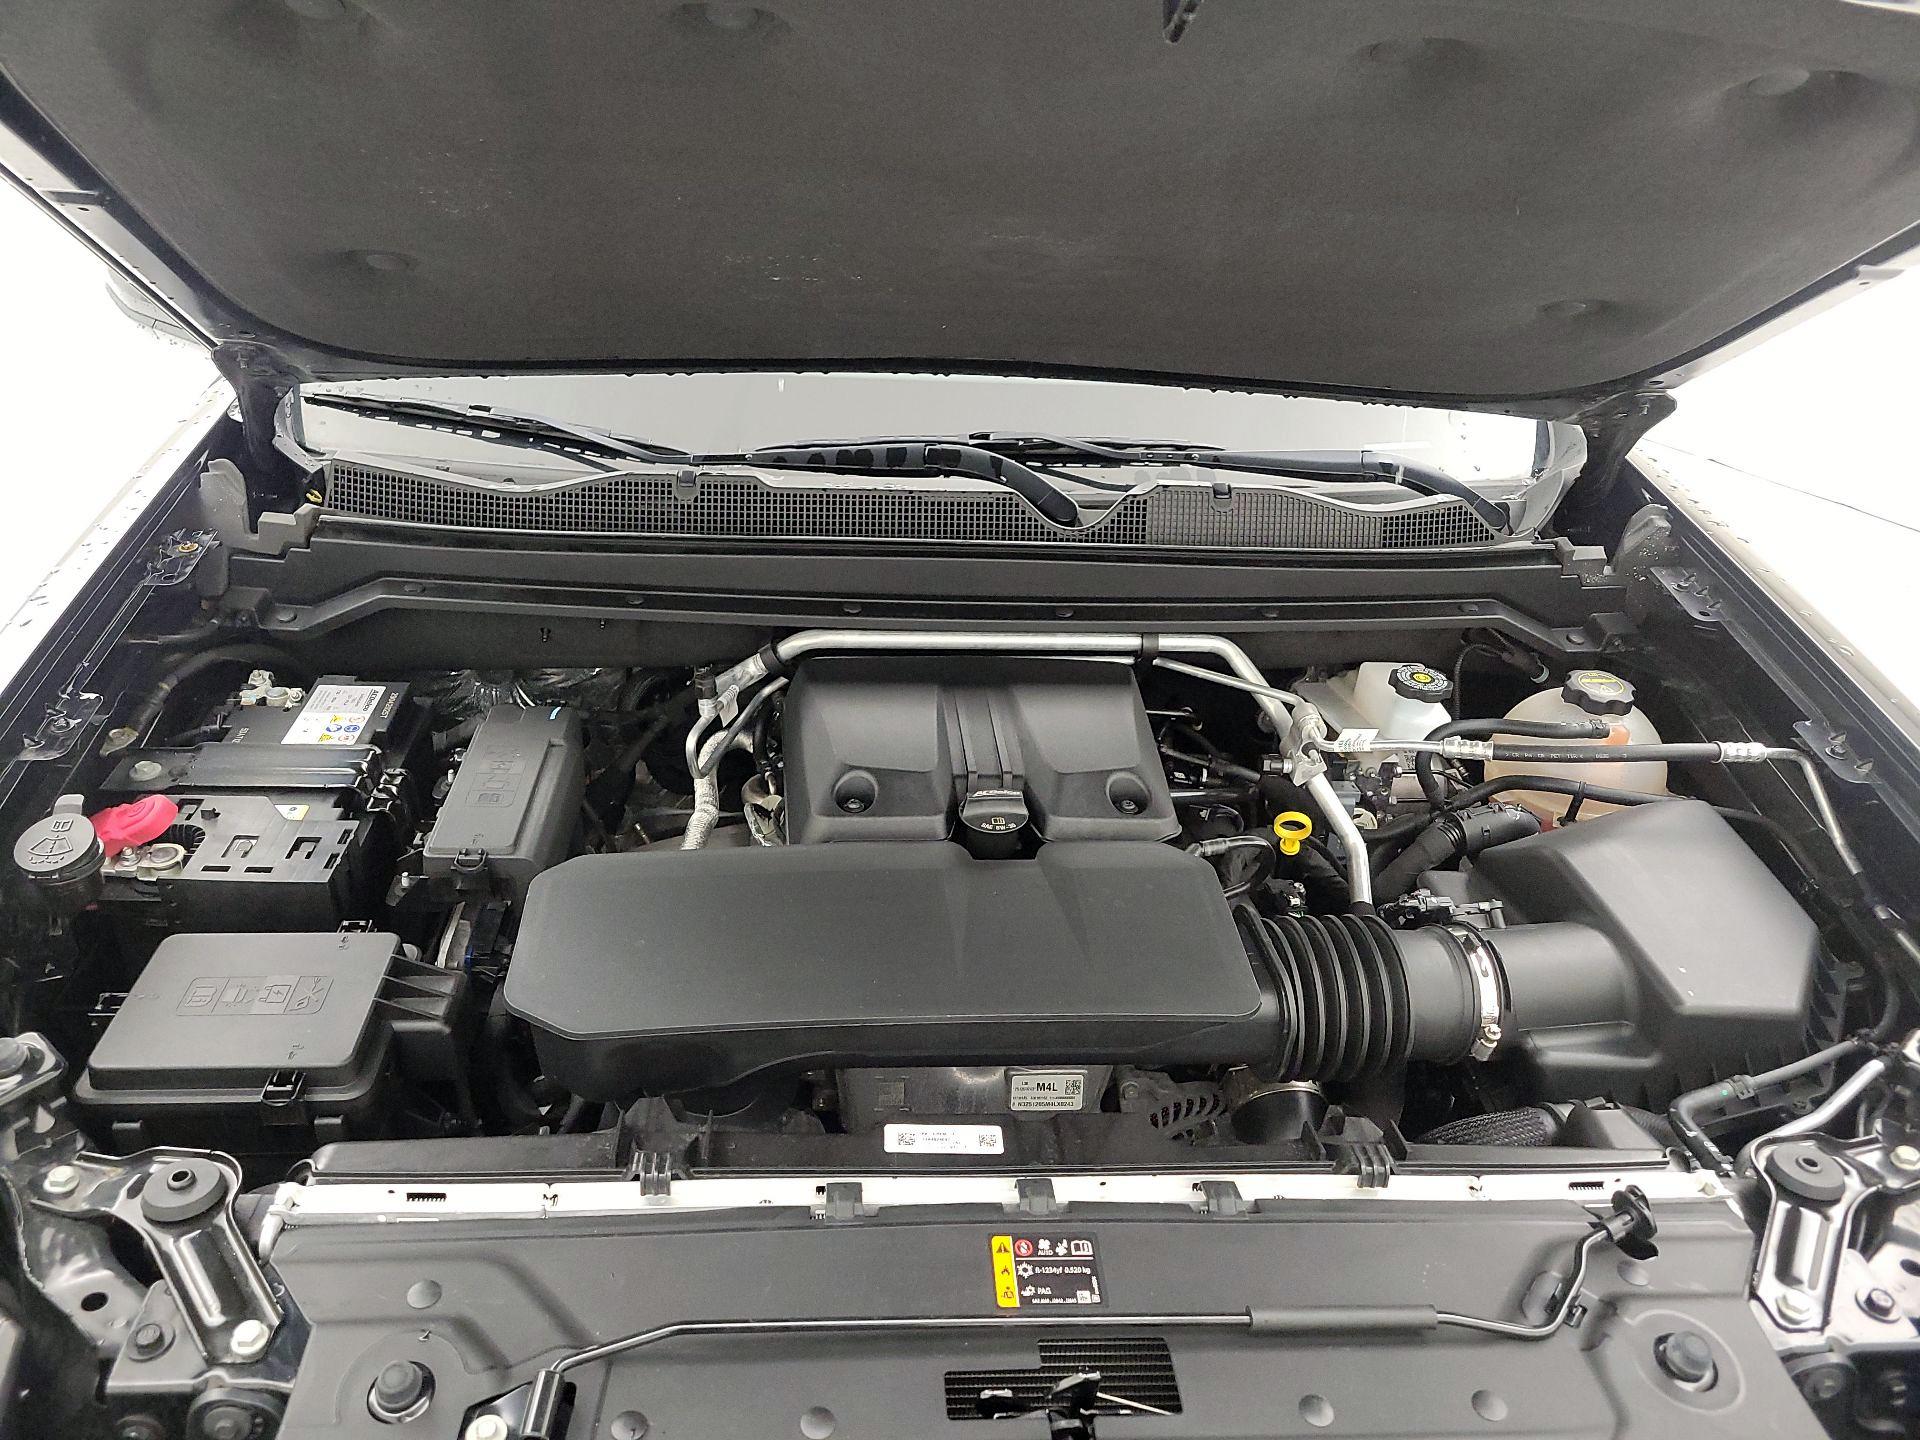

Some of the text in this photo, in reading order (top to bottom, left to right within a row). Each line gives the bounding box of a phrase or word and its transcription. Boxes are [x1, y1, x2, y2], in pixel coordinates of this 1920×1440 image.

[363, 689, 379, 712] ACDelco
[972, 789, 1021, 797] ACDelco
[1036, 1082, 1058, 1092] M4L
[1082, 1266, 1091, 1274] kg
